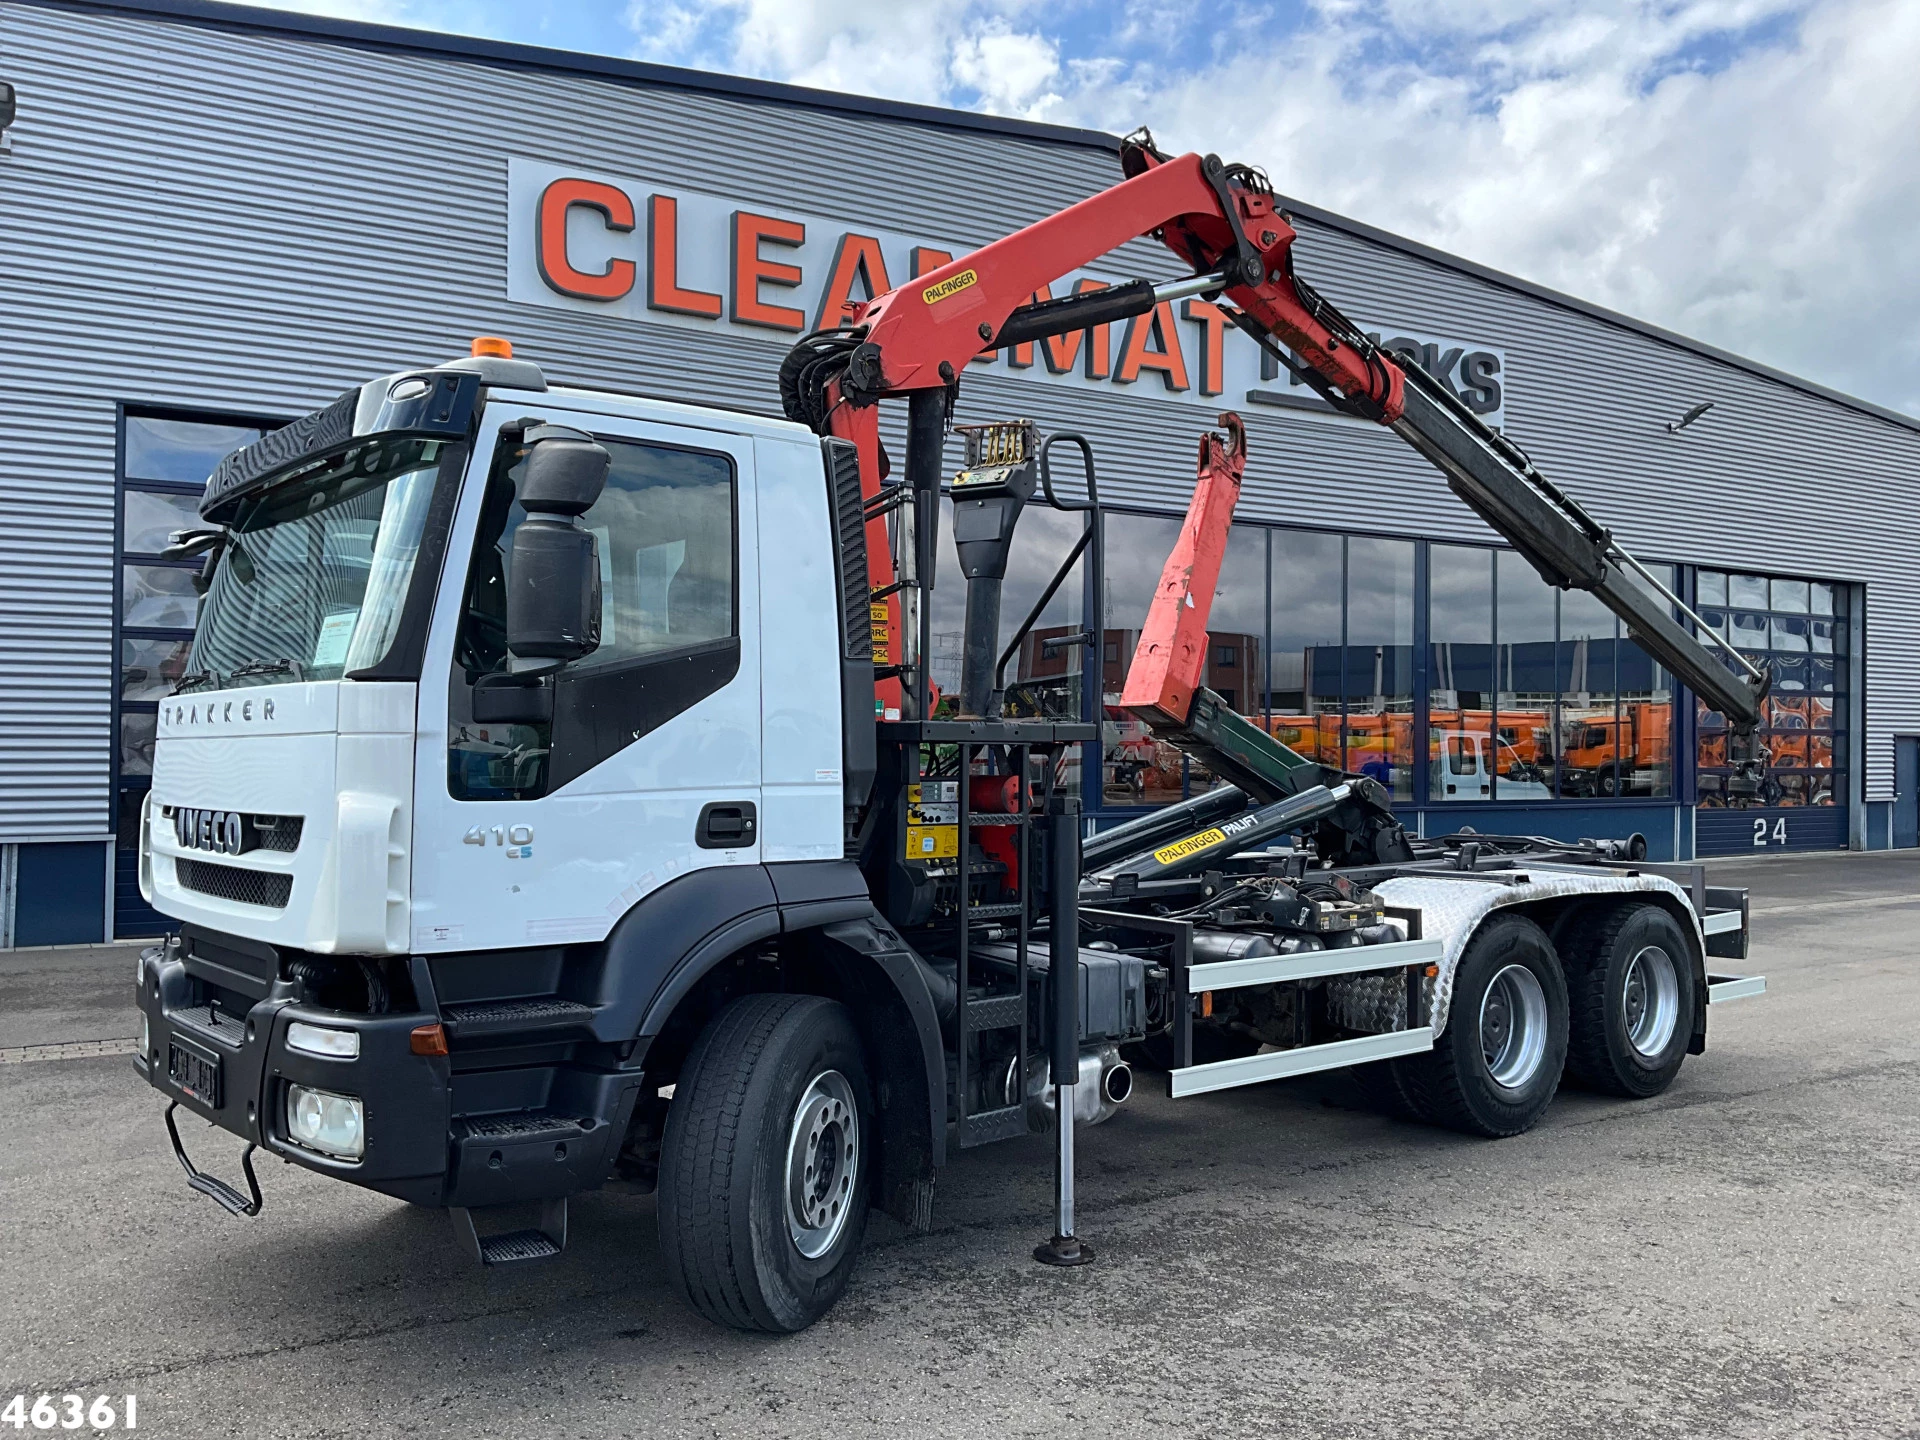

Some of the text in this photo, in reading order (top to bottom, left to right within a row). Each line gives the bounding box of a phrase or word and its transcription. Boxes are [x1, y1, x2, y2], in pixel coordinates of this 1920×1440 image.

[925, 271, 975, 302] PALFINGER
[165, 698, 275, 726] TRAKKER
[177, 808, 243, 857] IVECO
[463, 823, 534, 847] 410
[1158, 815, 1259, 862] PALFINGER PALIFT
[1753, 817, 1787, 846] 24
[506, 846, 533, 858] E5
